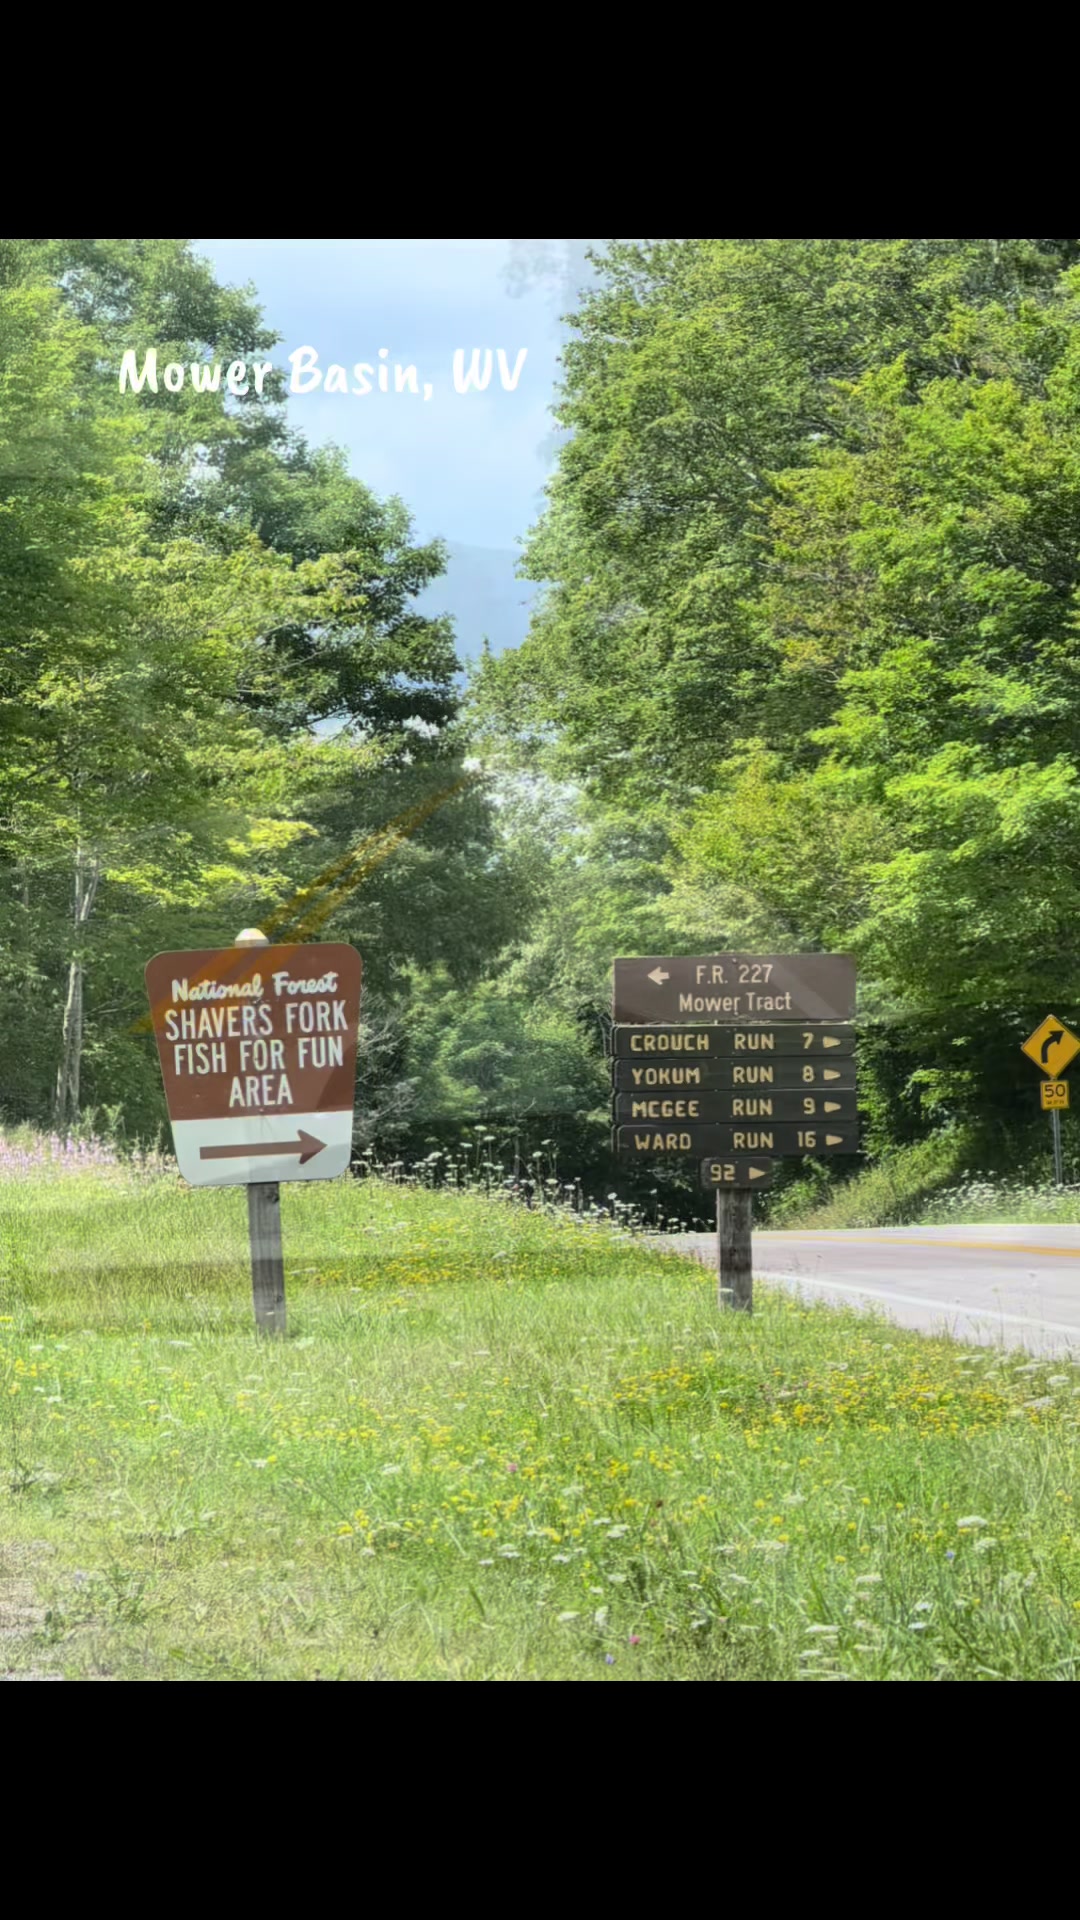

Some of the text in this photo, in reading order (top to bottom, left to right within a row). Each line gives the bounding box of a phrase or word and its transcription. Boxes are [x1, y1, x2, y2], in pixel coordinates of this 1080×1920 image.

[695, 964, 774, 985] F.R. 227
[171, 971, 339, 1003] National Forest
[678, 991, 792, 1013] Mower Tract
[164, 1000, 349, 1041] SHAVERS FORK
[630, 1032, 815, 1052] CROUCH RUN 7
[173, 1035, 344, 1076] FISH FOR FUN
[631, 1065, 815, 1085] YOKUM RUN 8
[228, 1073, 294, 1108] AREA
[1044, 1084, 1066, 1098] 50
[631, 1097, 816, 1118] MCGEE RUN 9
[634, 1131, 817, 1151] WARD RUN 16
[710, 1164, 736, 1182] 92
